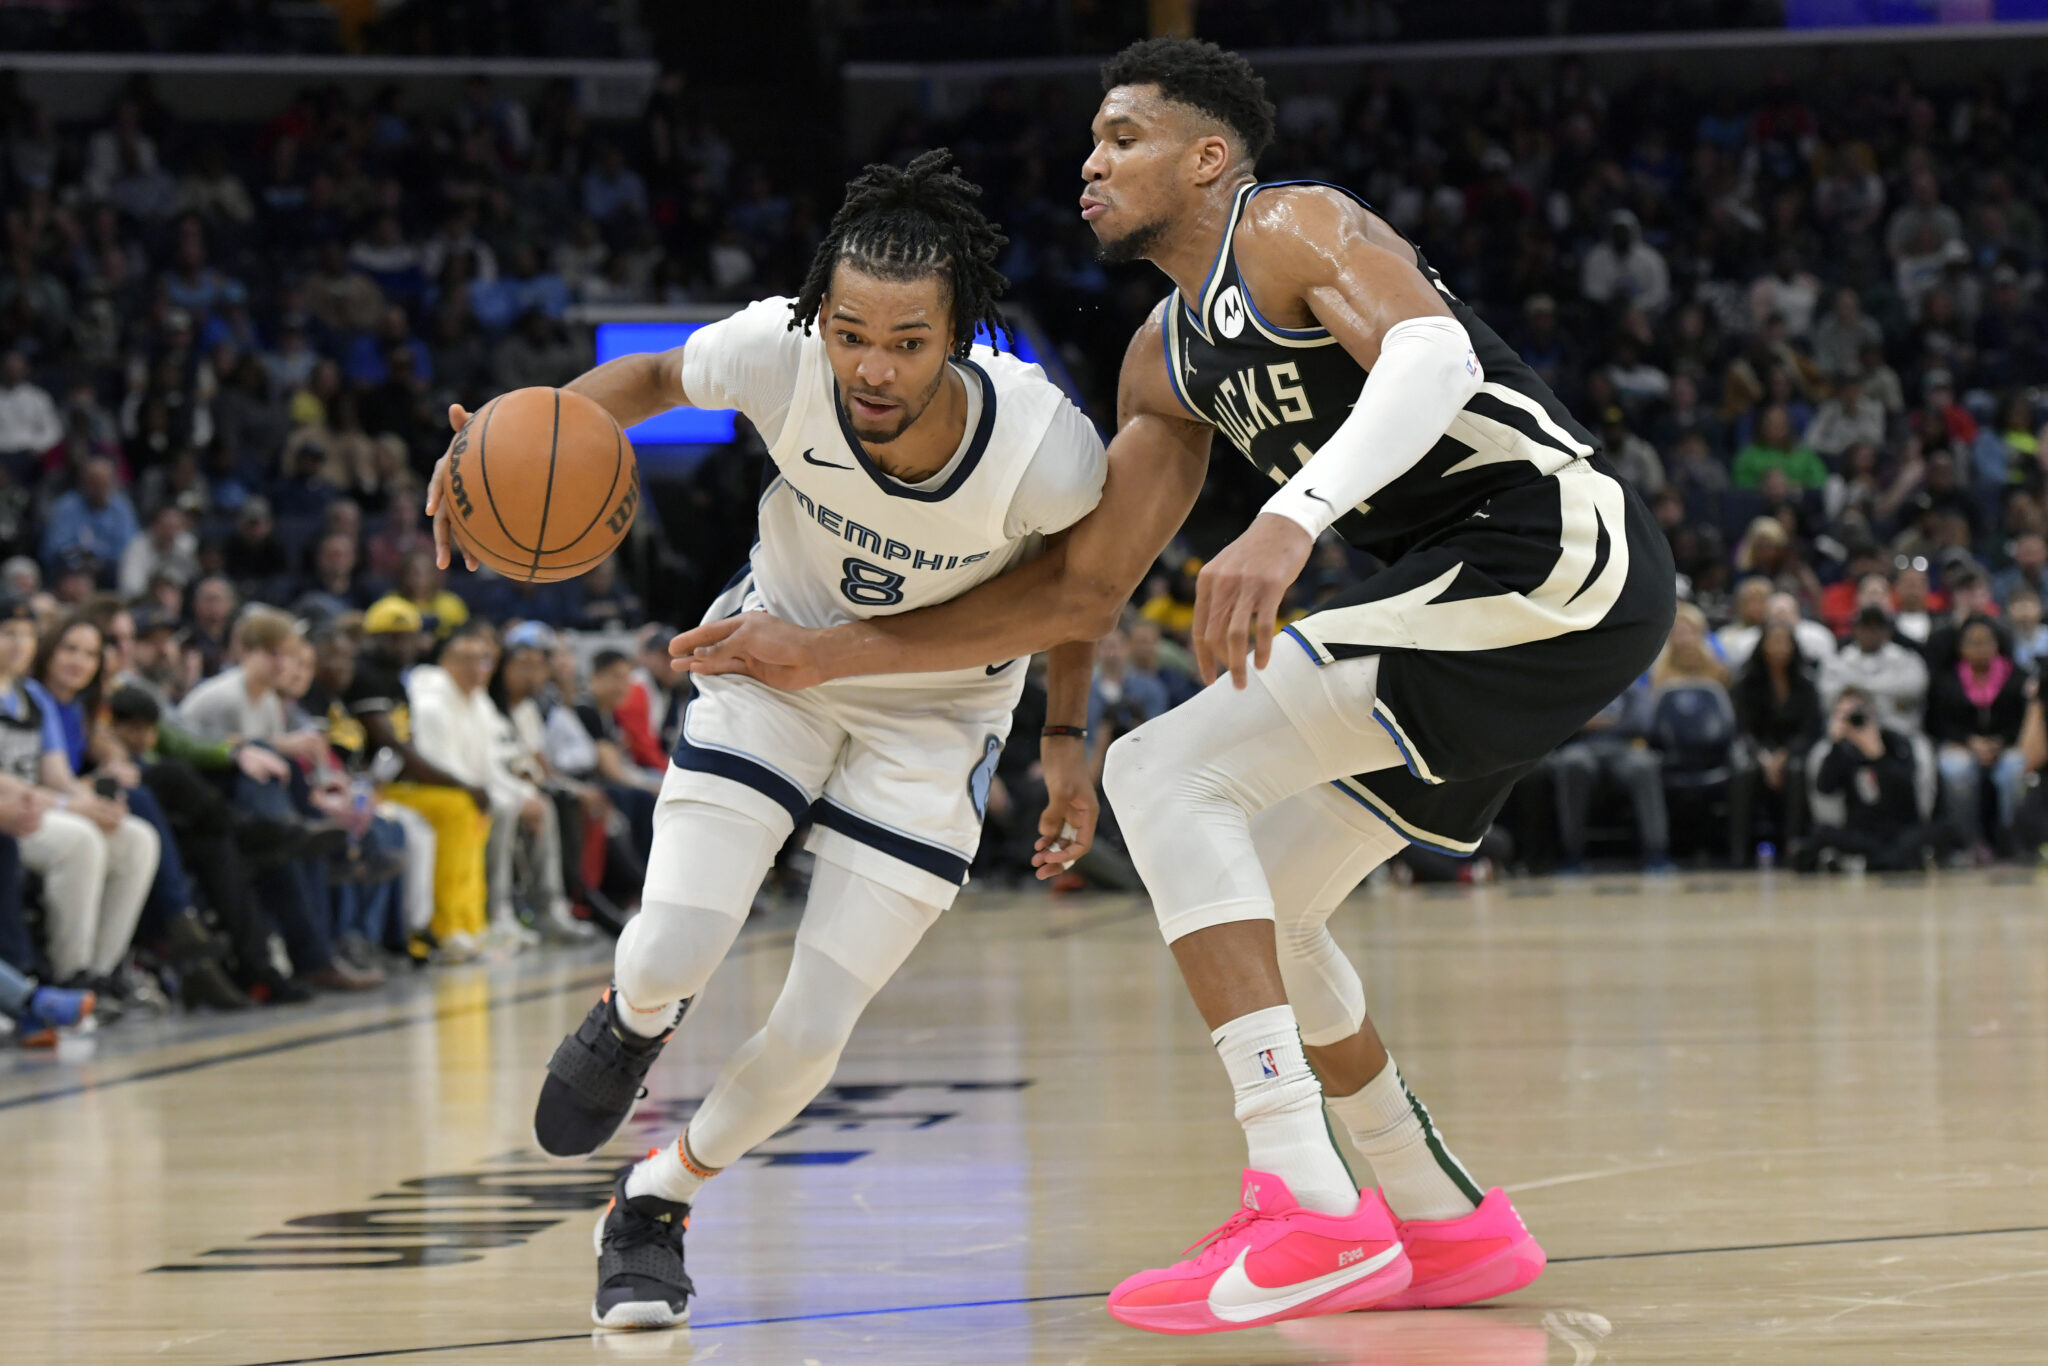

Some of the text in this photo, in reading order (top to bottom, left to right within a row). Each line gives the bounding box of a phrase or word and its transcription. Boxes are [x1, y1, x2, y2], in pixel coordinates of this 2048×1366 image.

[1214, 361, 1313, 468] UCKS
[784, 478, 990, 571] MEMPHIS
[840, 557, 906, 606] 8
